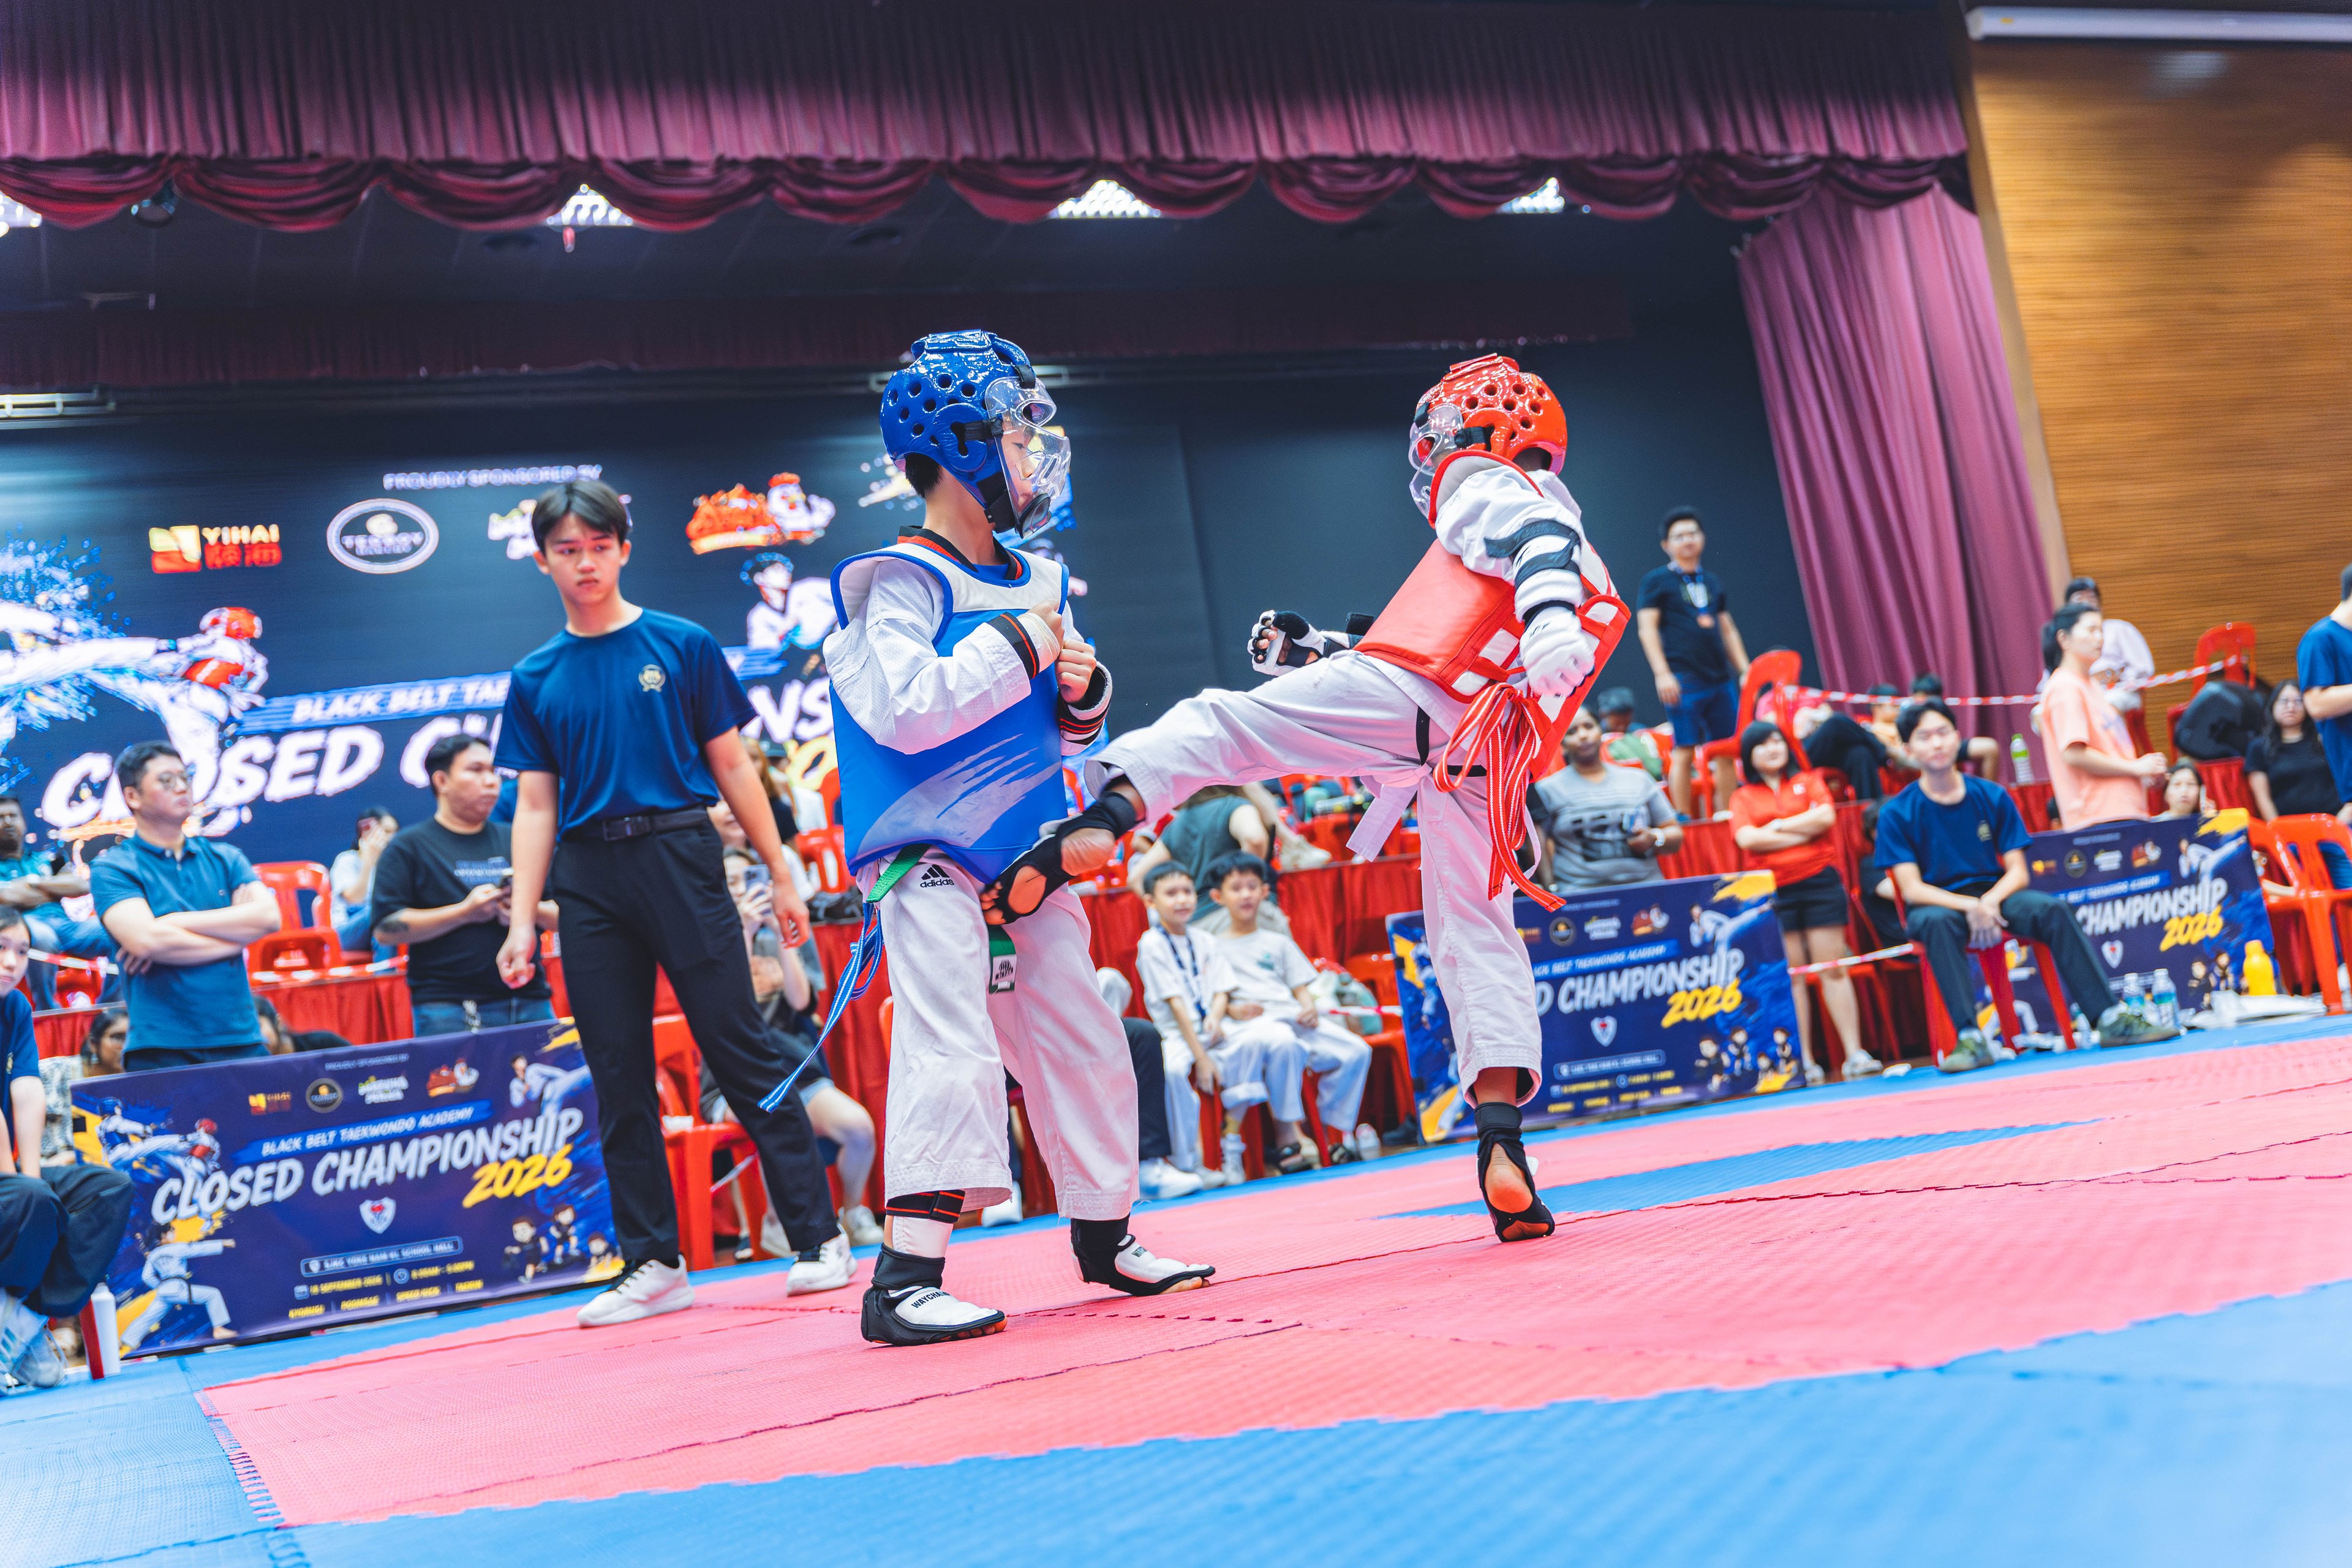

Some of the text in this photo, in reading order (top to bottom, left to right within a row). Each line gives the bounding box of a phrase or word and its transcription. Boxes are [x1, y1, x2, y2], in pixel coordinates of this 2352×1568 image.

[202, 524, 280, 545] YIHAI
[291, 690, 384, 723] BLACK
[386, 683, 458, 714] BELT
[920, 879, 954, 888] adidas
[2159, 905, 2224, 952] 2026
[1558, 948, 1744, 1015] CHAMPIONSHIP
[1661, 977, 1743, 1028] 2026
[262, 1106, 475, 1157] BLACK BELT TAEKWONDO ACADEMY
[151, 1107, 584, 1225] CLOSED CHAMPIONSHIP
[461, 1144, 573, 1208] 2026
